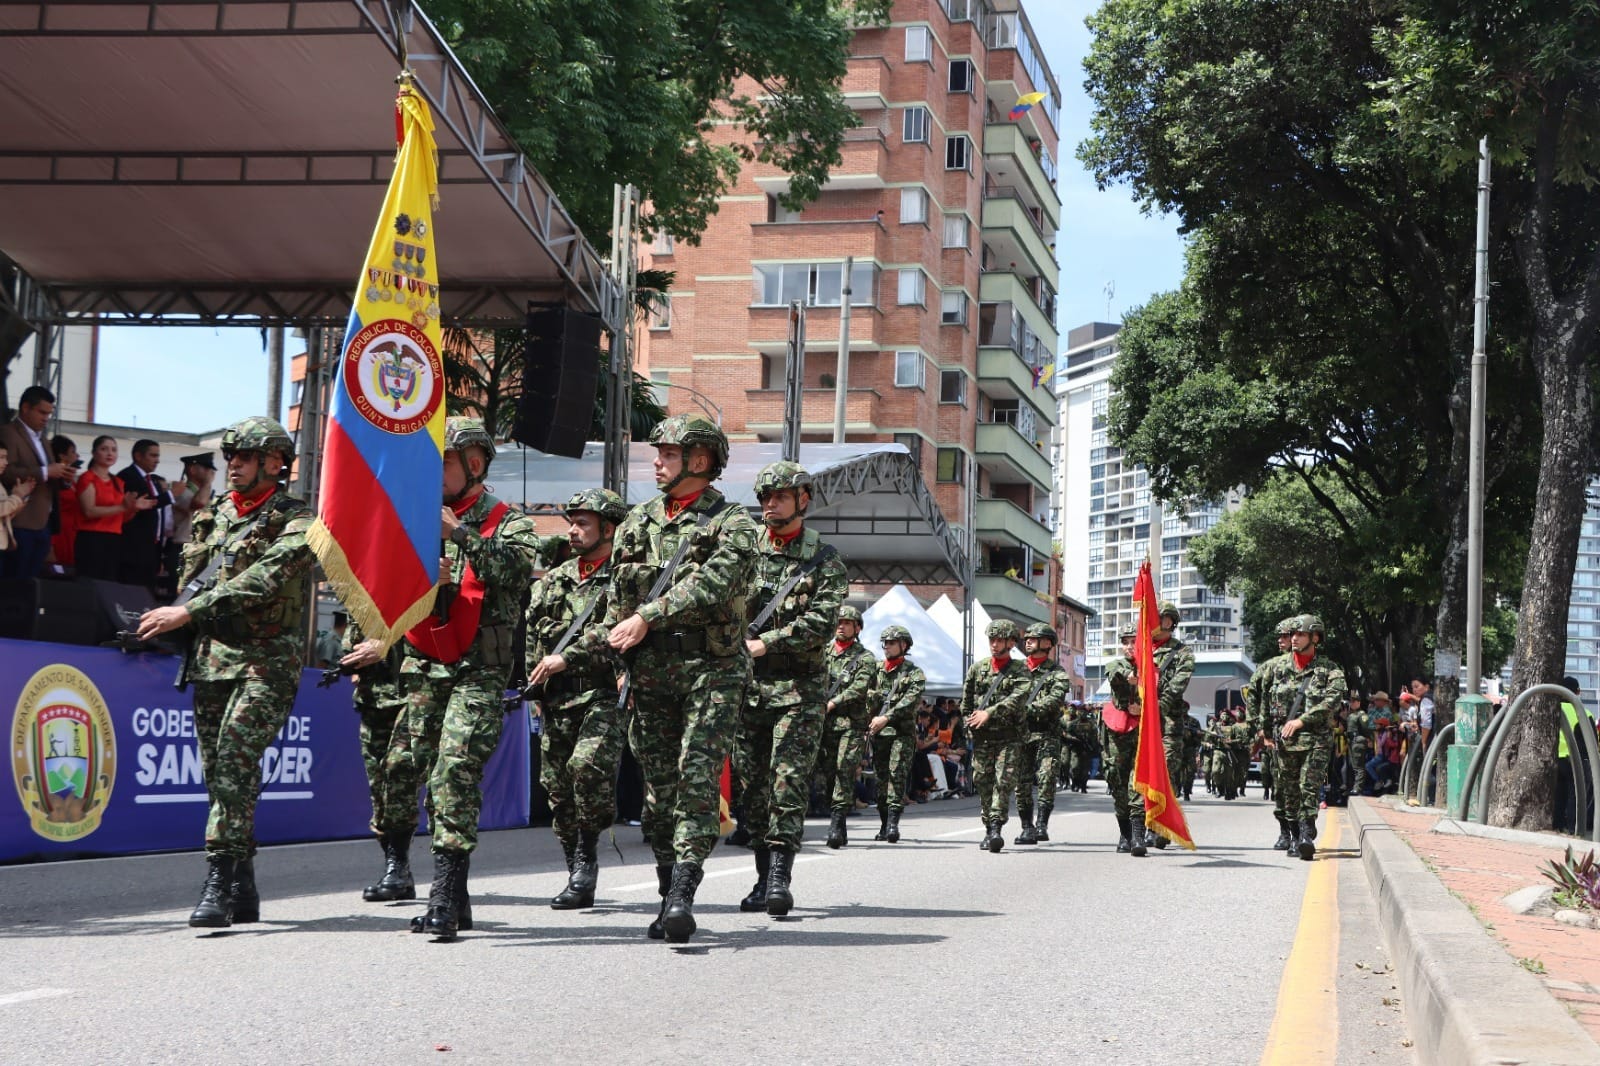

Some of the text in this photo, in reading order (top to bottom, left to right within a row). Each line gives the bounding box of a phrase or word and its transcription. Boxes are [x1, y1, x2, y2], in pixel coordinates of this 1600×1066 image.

[394, 323, 407, 333] DE
[410, 330, 441, 379] COLOMBIA
[356, 395, 432, 433] QUINTA BRIGADA
[17, 671, 64, 745] DEPARTAMENTO
[65, 672, 77, 686] DE
[78, 679, 112, 746] SANTANDER
[288, 716, 311, 741] DE
[136, 743, 312, 786] SANDER
